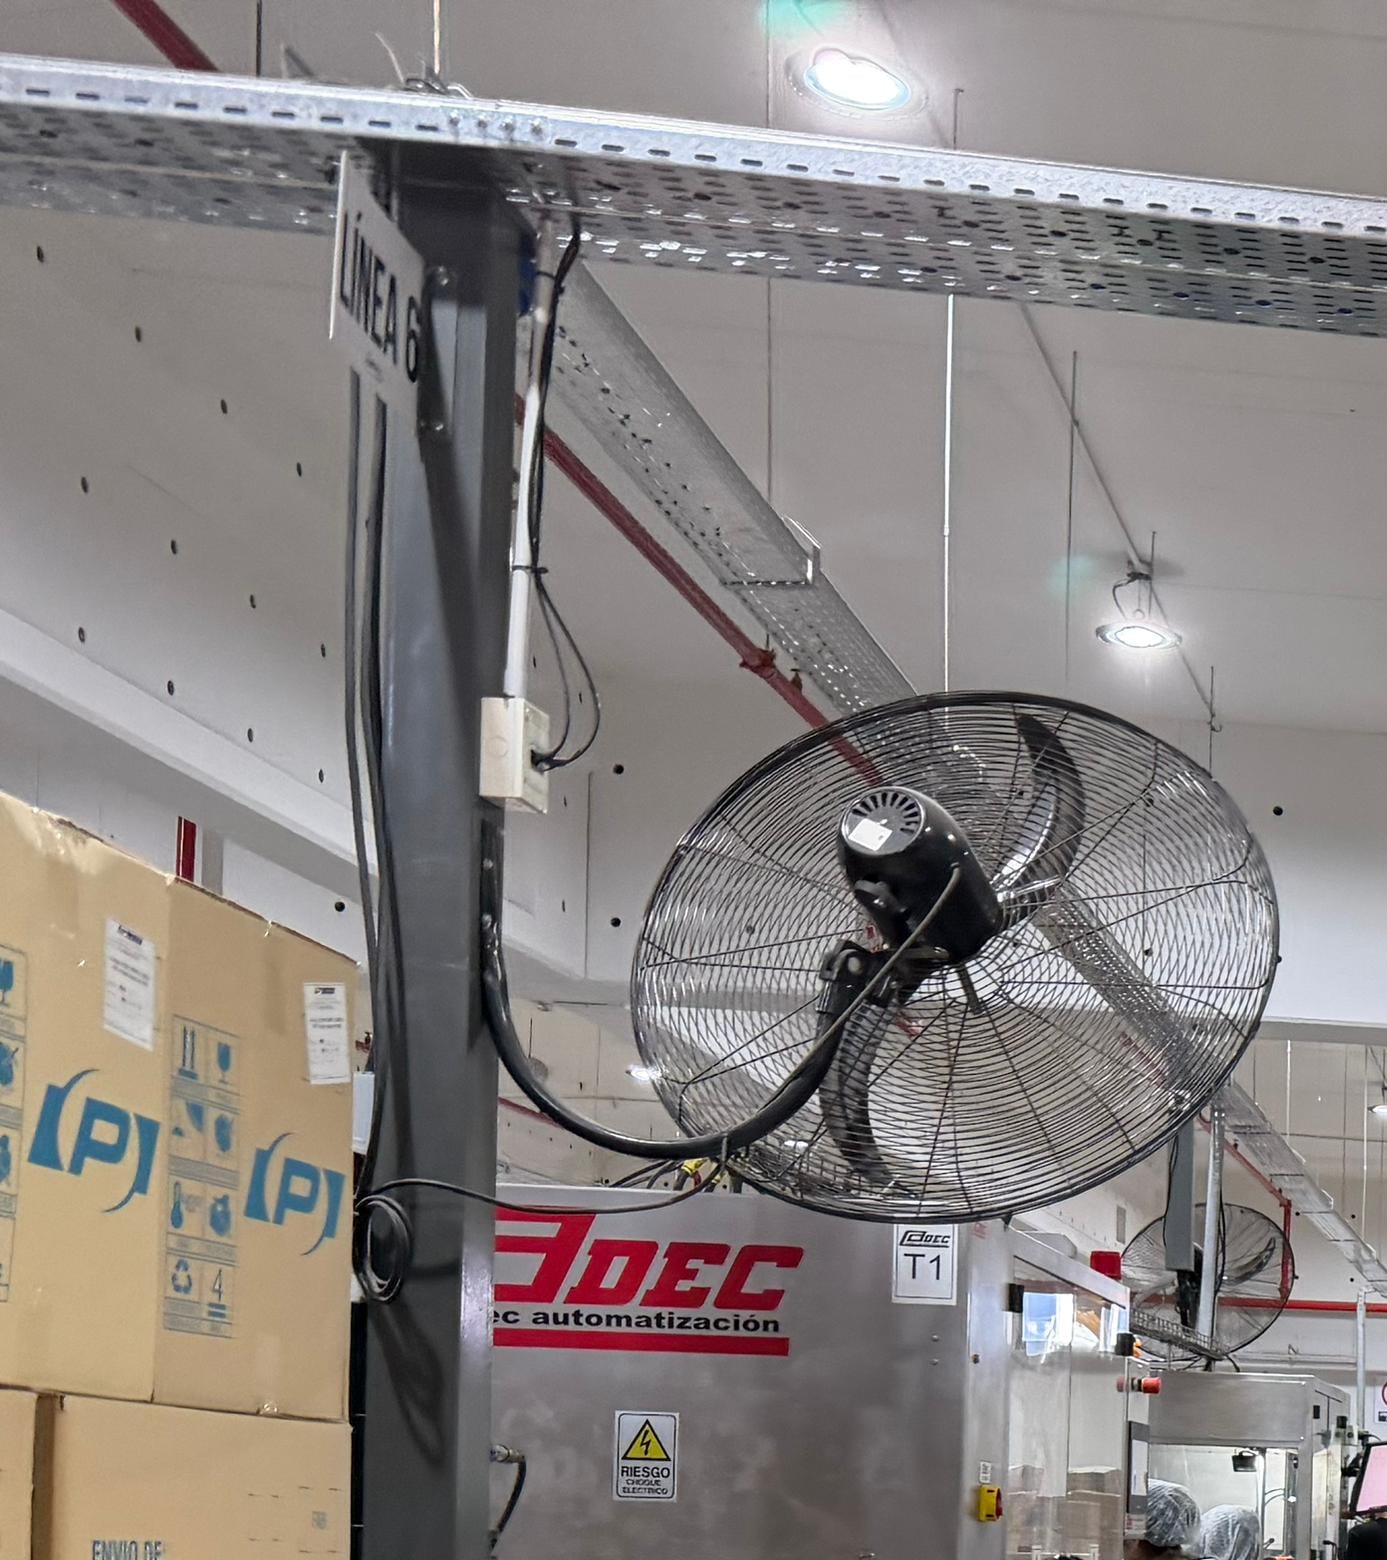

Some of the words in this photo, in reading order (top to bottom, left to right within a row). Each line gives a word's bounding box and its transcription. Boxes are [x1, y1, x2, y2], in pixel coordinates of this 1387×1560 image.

[406, 296, 421, 383] 6
[903, 1253, 941, 1281] T1
[532, 1309, 780, 1333] automatización
[621, 1466, 671, 1479] RIESGO
